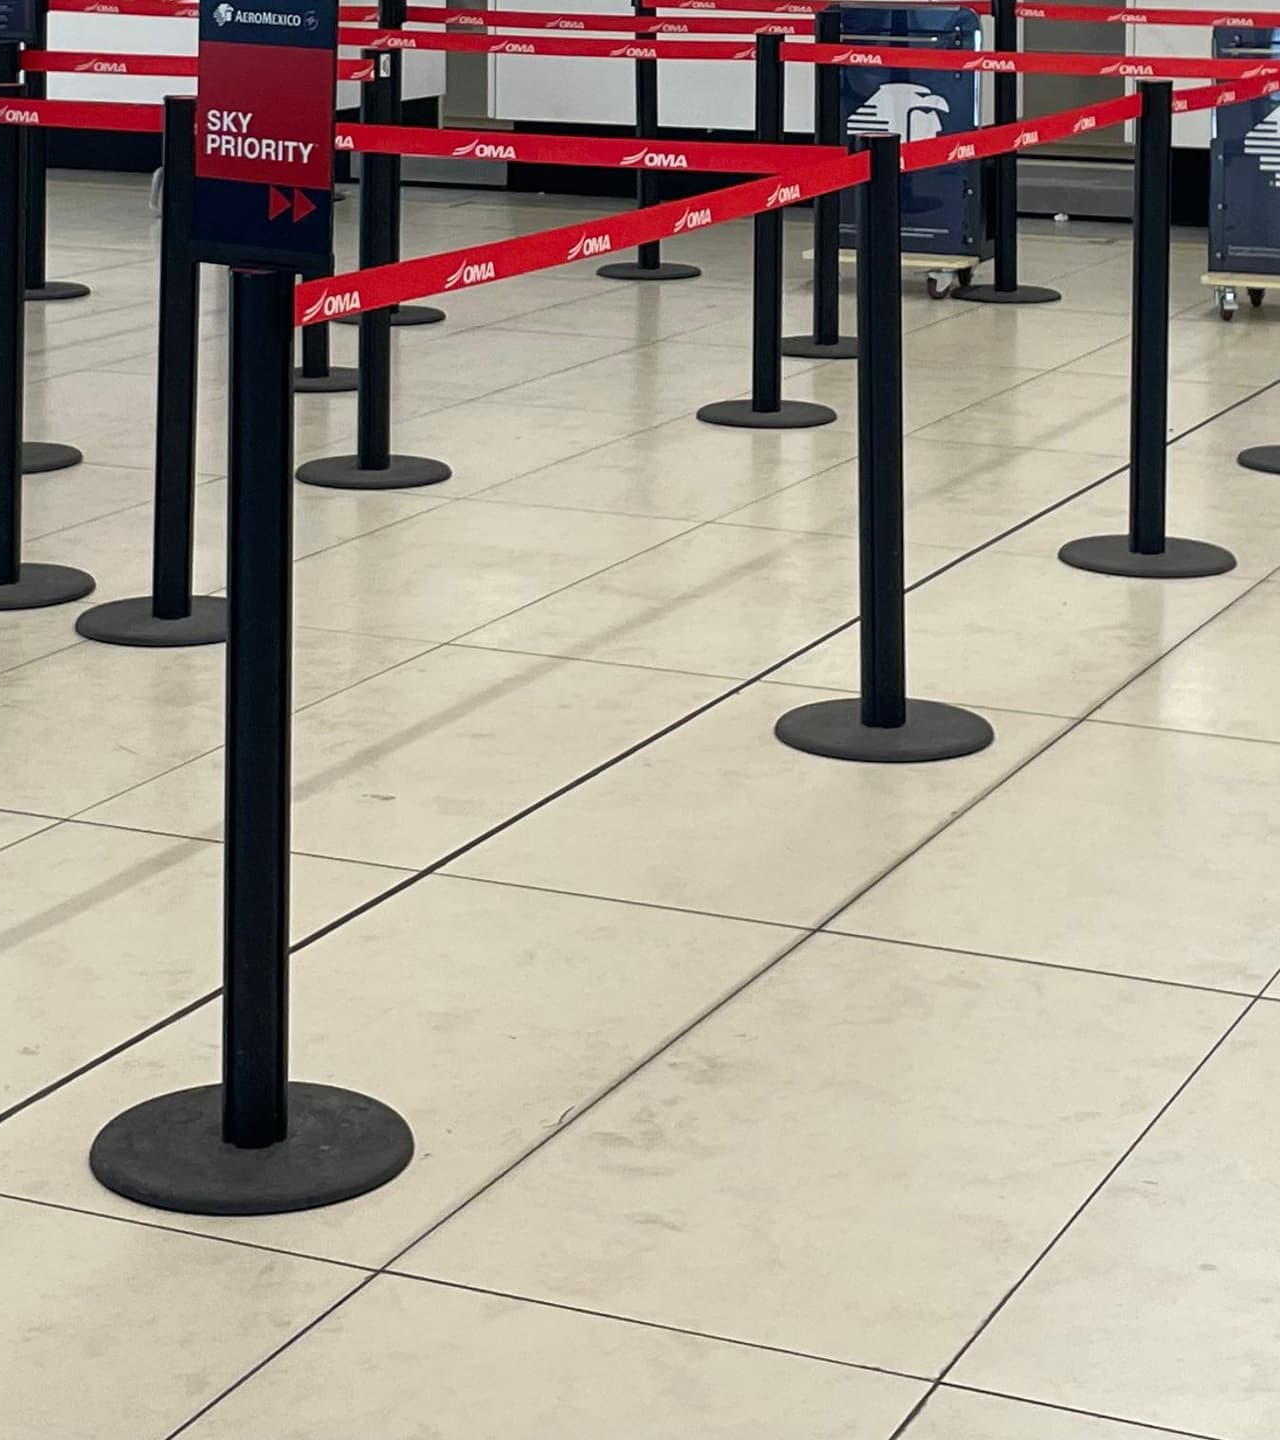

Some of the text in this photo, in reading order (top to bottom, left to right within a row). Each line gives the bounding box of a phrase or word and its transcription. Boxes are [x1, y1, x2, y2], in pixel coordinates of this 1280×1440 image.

[235, 10, 301, 27] AEROMEXICO
[387, 37, 657, 58] OMA OMA OMA
[94, 62, 127, 72] OMA
[850, 53, 1154, 76] OMA OMA OMA
[5, 109, 39, 124] OMA
[207, 110, 253, 134] SKY
[206, 134, 313, 165] PRIORITY
[335, 136, 687, 168] MA OMA OMA
[957, 143, 975, 159] OMA
[324, 184, 800, 317] OMA OMA OMA OMA OMA
